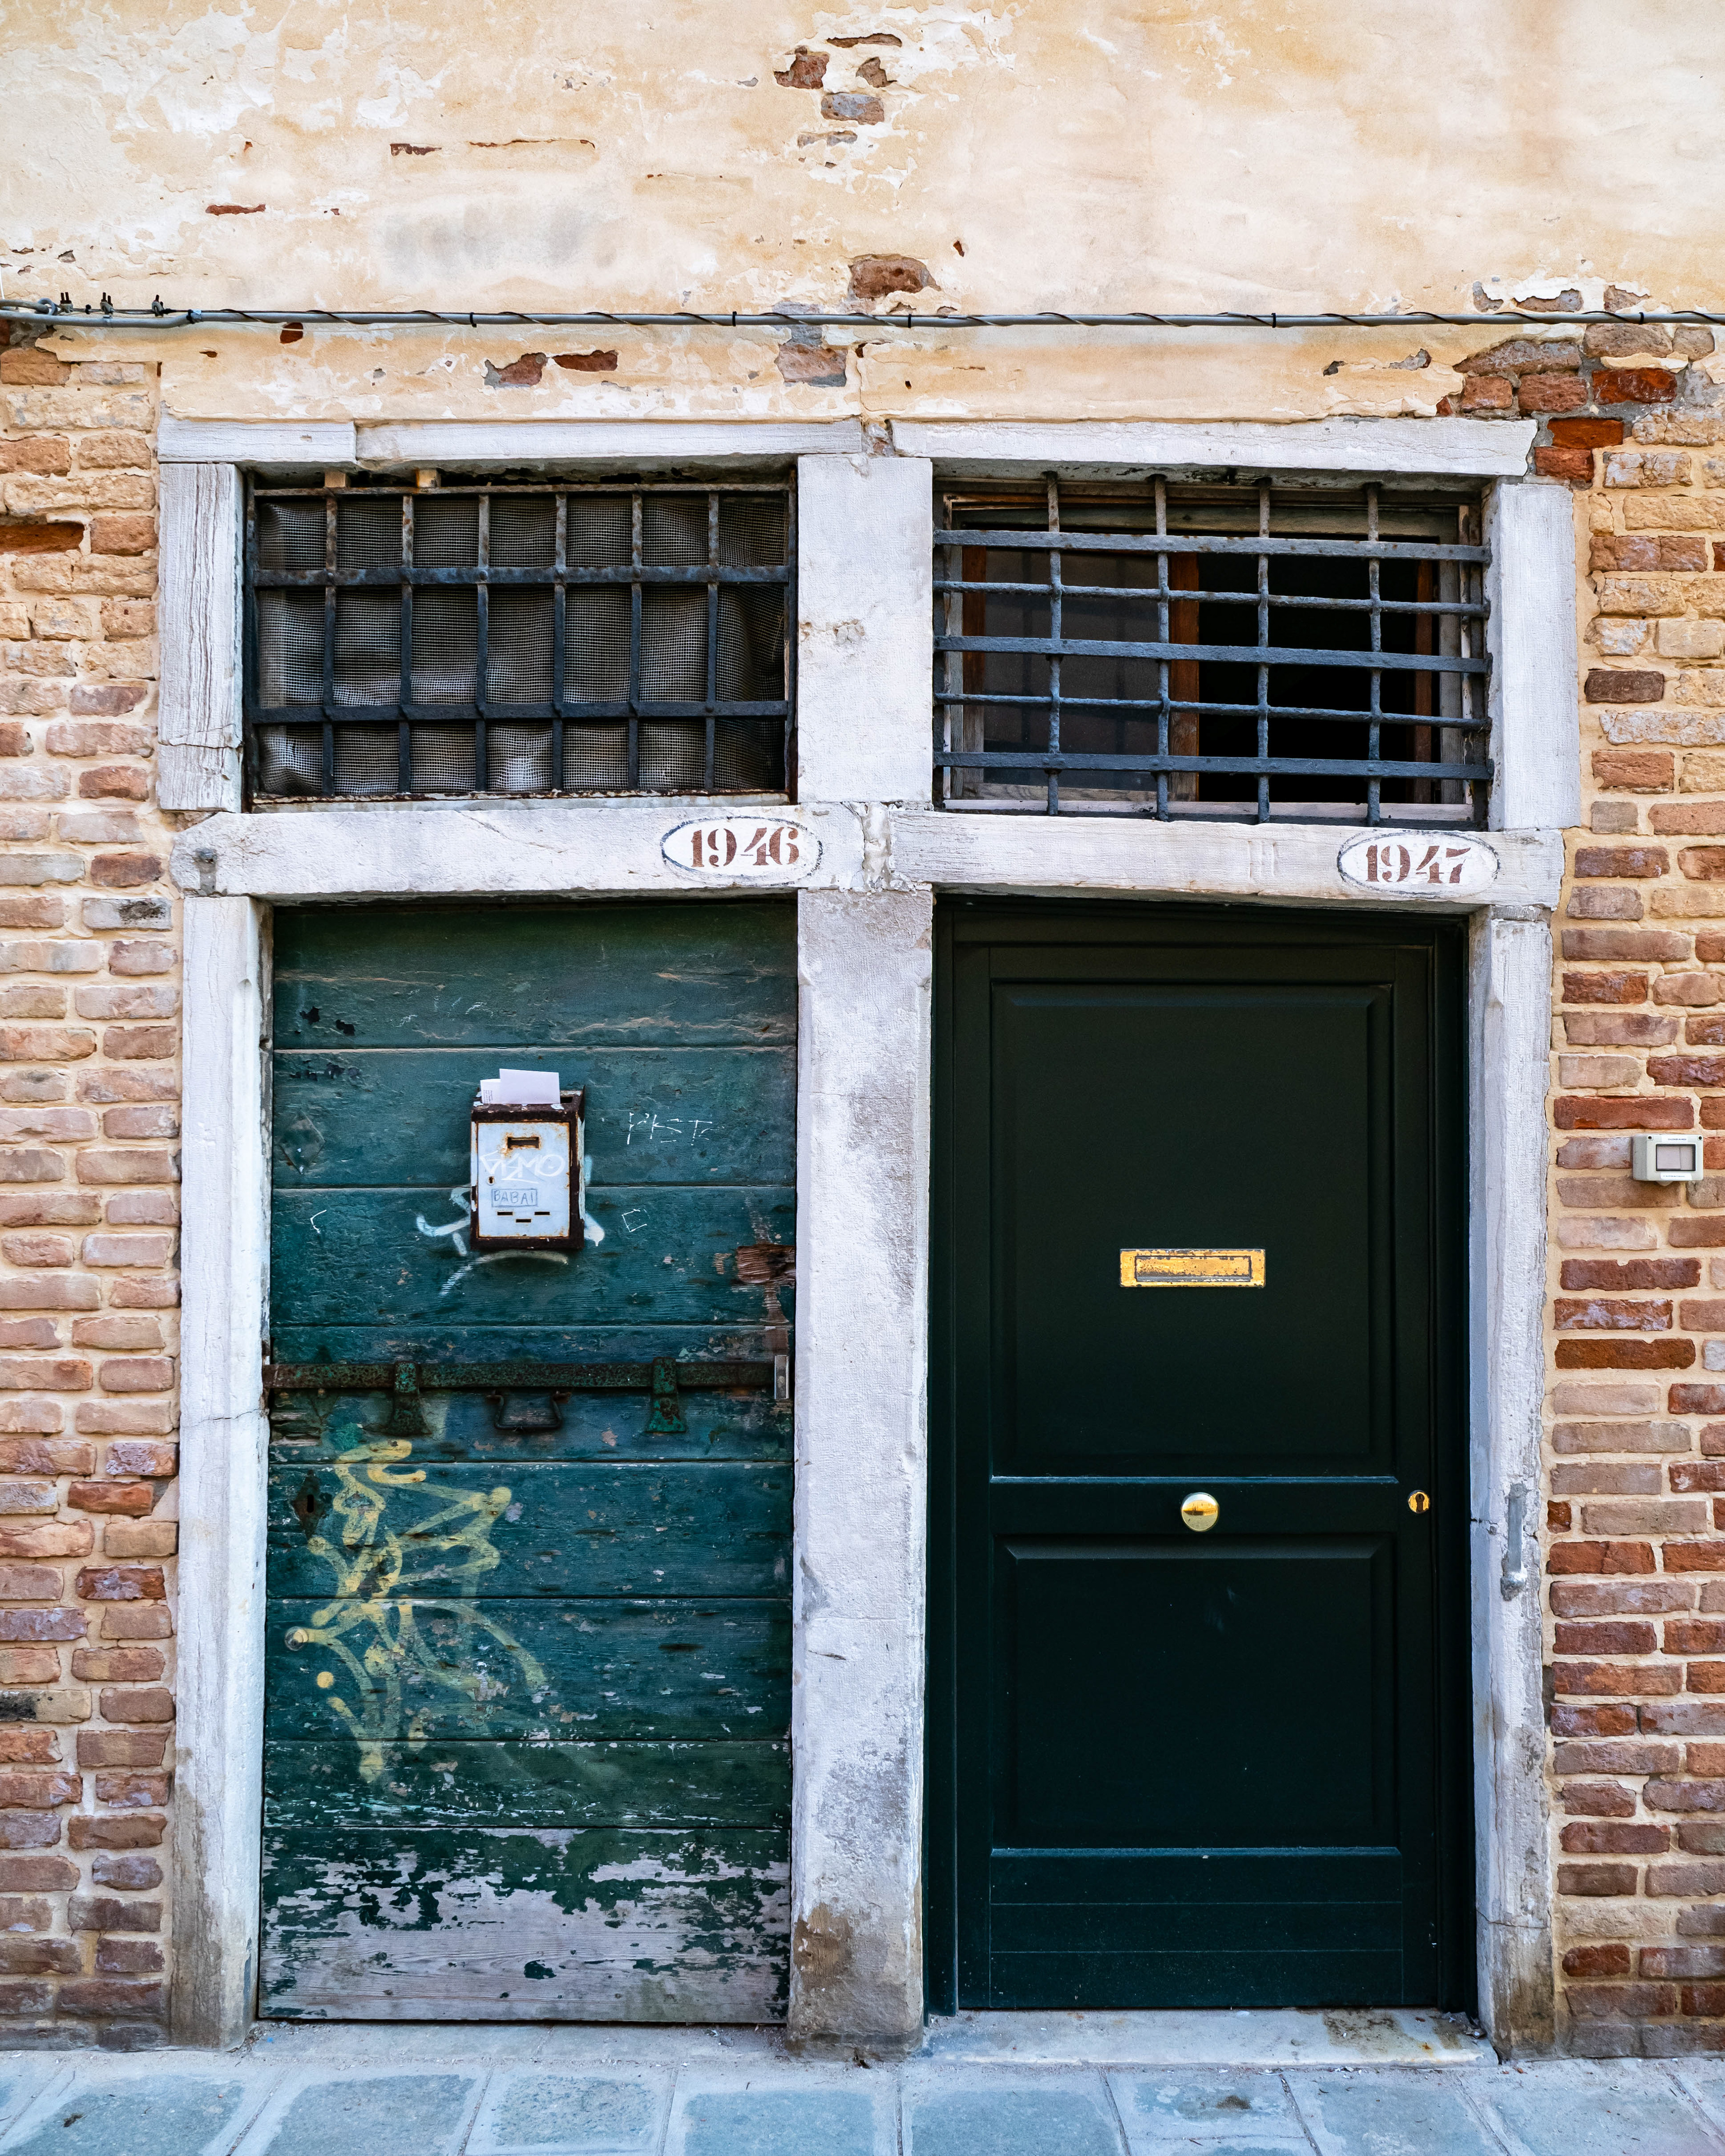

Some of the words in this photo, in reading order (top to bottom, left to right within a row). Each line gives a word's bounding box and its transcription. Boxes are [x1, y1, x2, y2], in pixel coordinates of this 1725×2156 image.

[691, 826, 800, 867] 1946
[1365, 844, 1471, 884] 1947
[494, 1189, 534, 1205] BABAI
